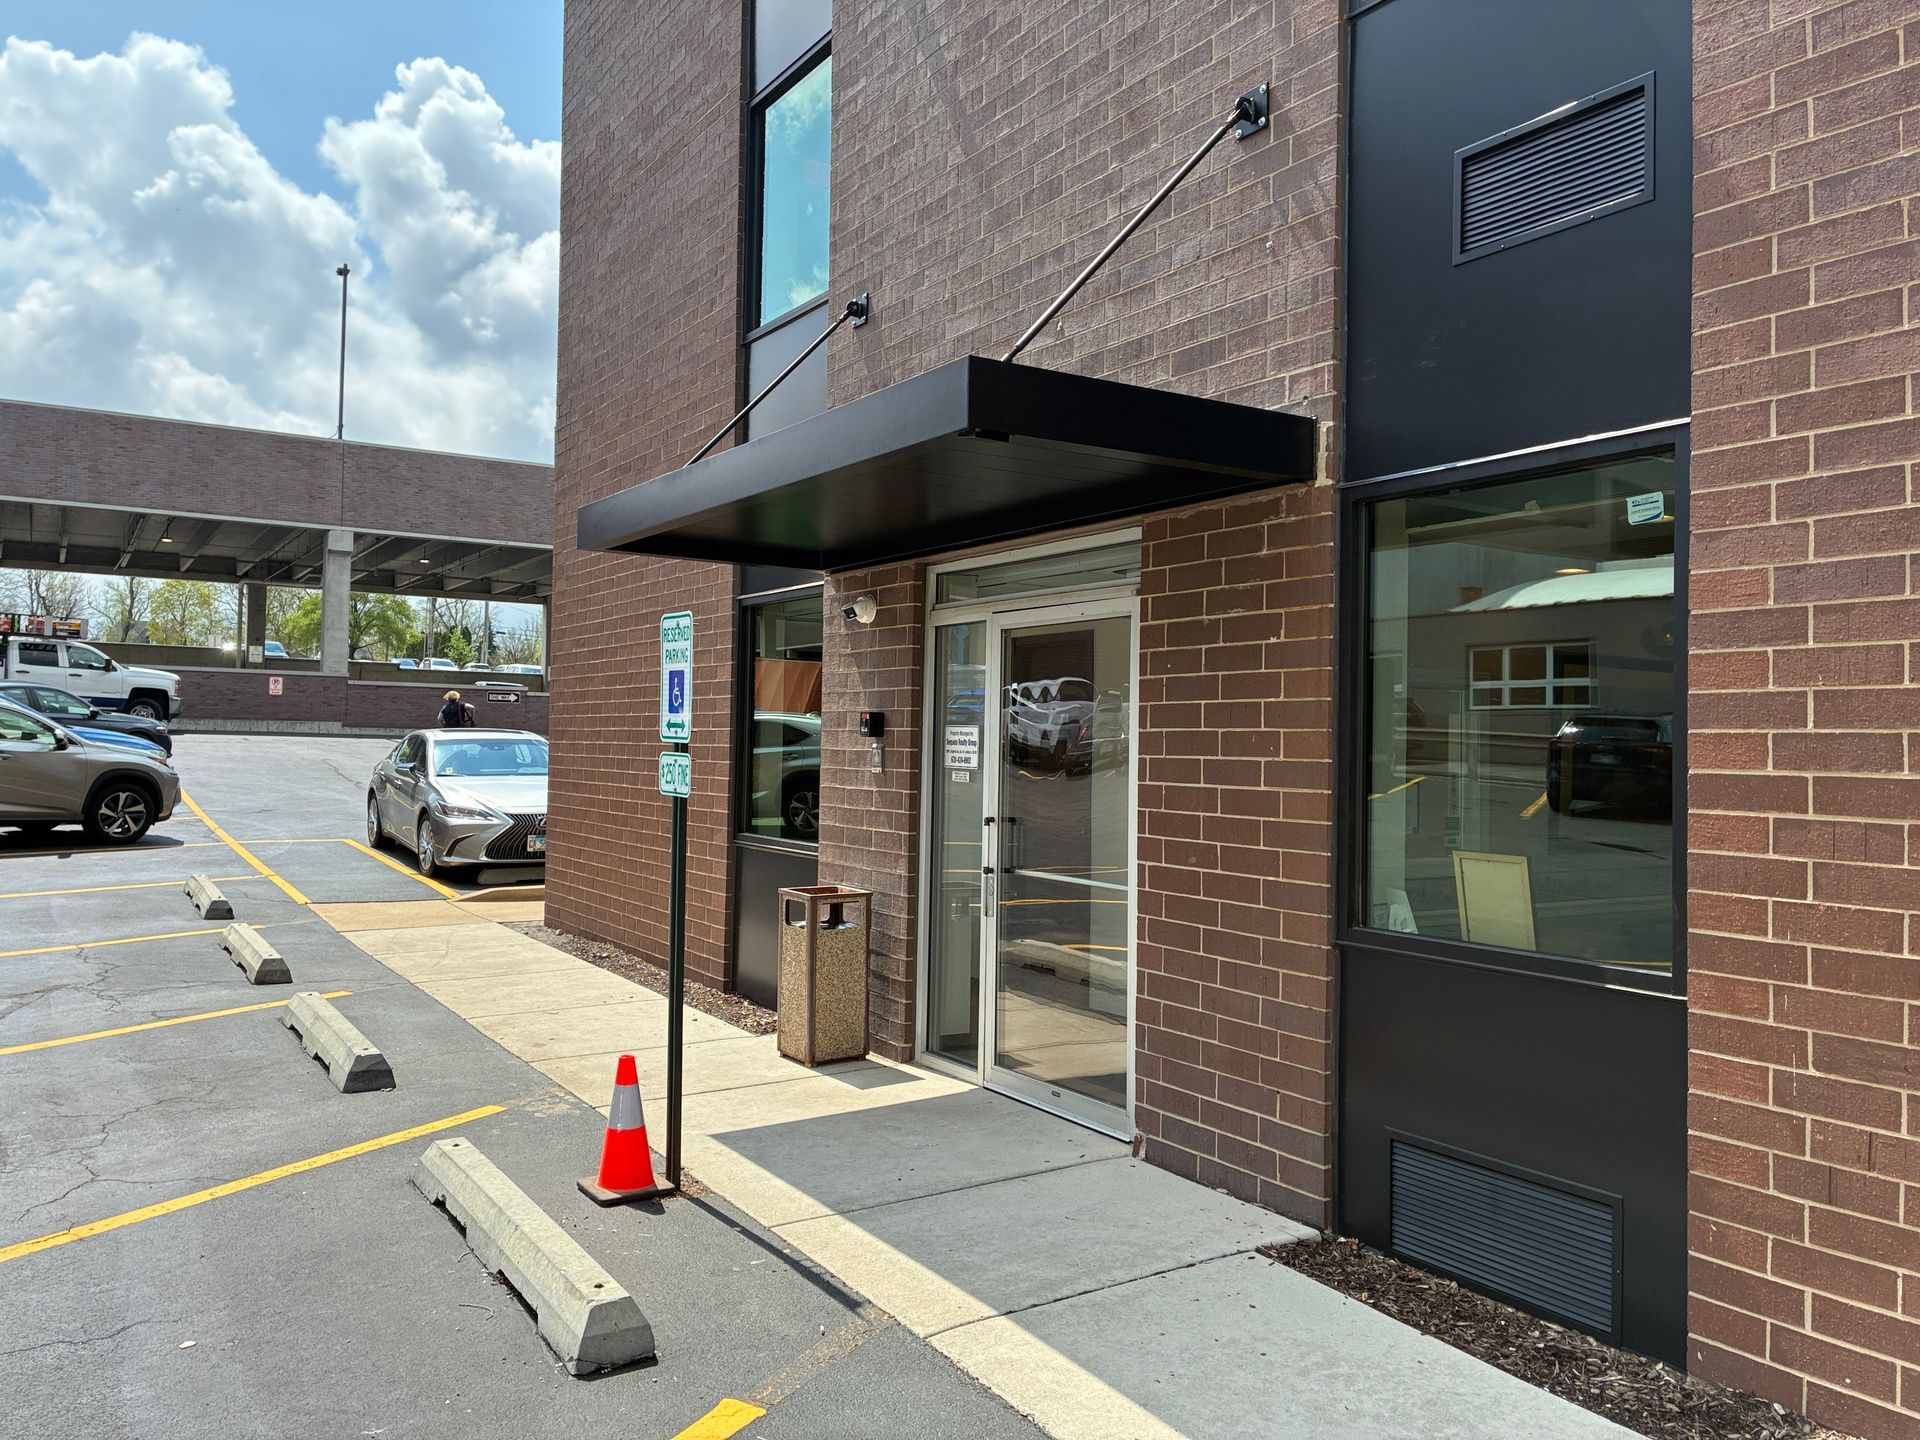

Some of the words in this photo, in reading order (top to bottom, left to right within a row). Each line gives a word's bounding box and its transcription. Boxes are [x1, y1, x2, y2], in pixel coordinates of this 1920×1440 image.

[663, 625, 690, 643] RESERVED
[665, 647, 689, 664] PARKING
[677, 763, 689, 787] FINE
